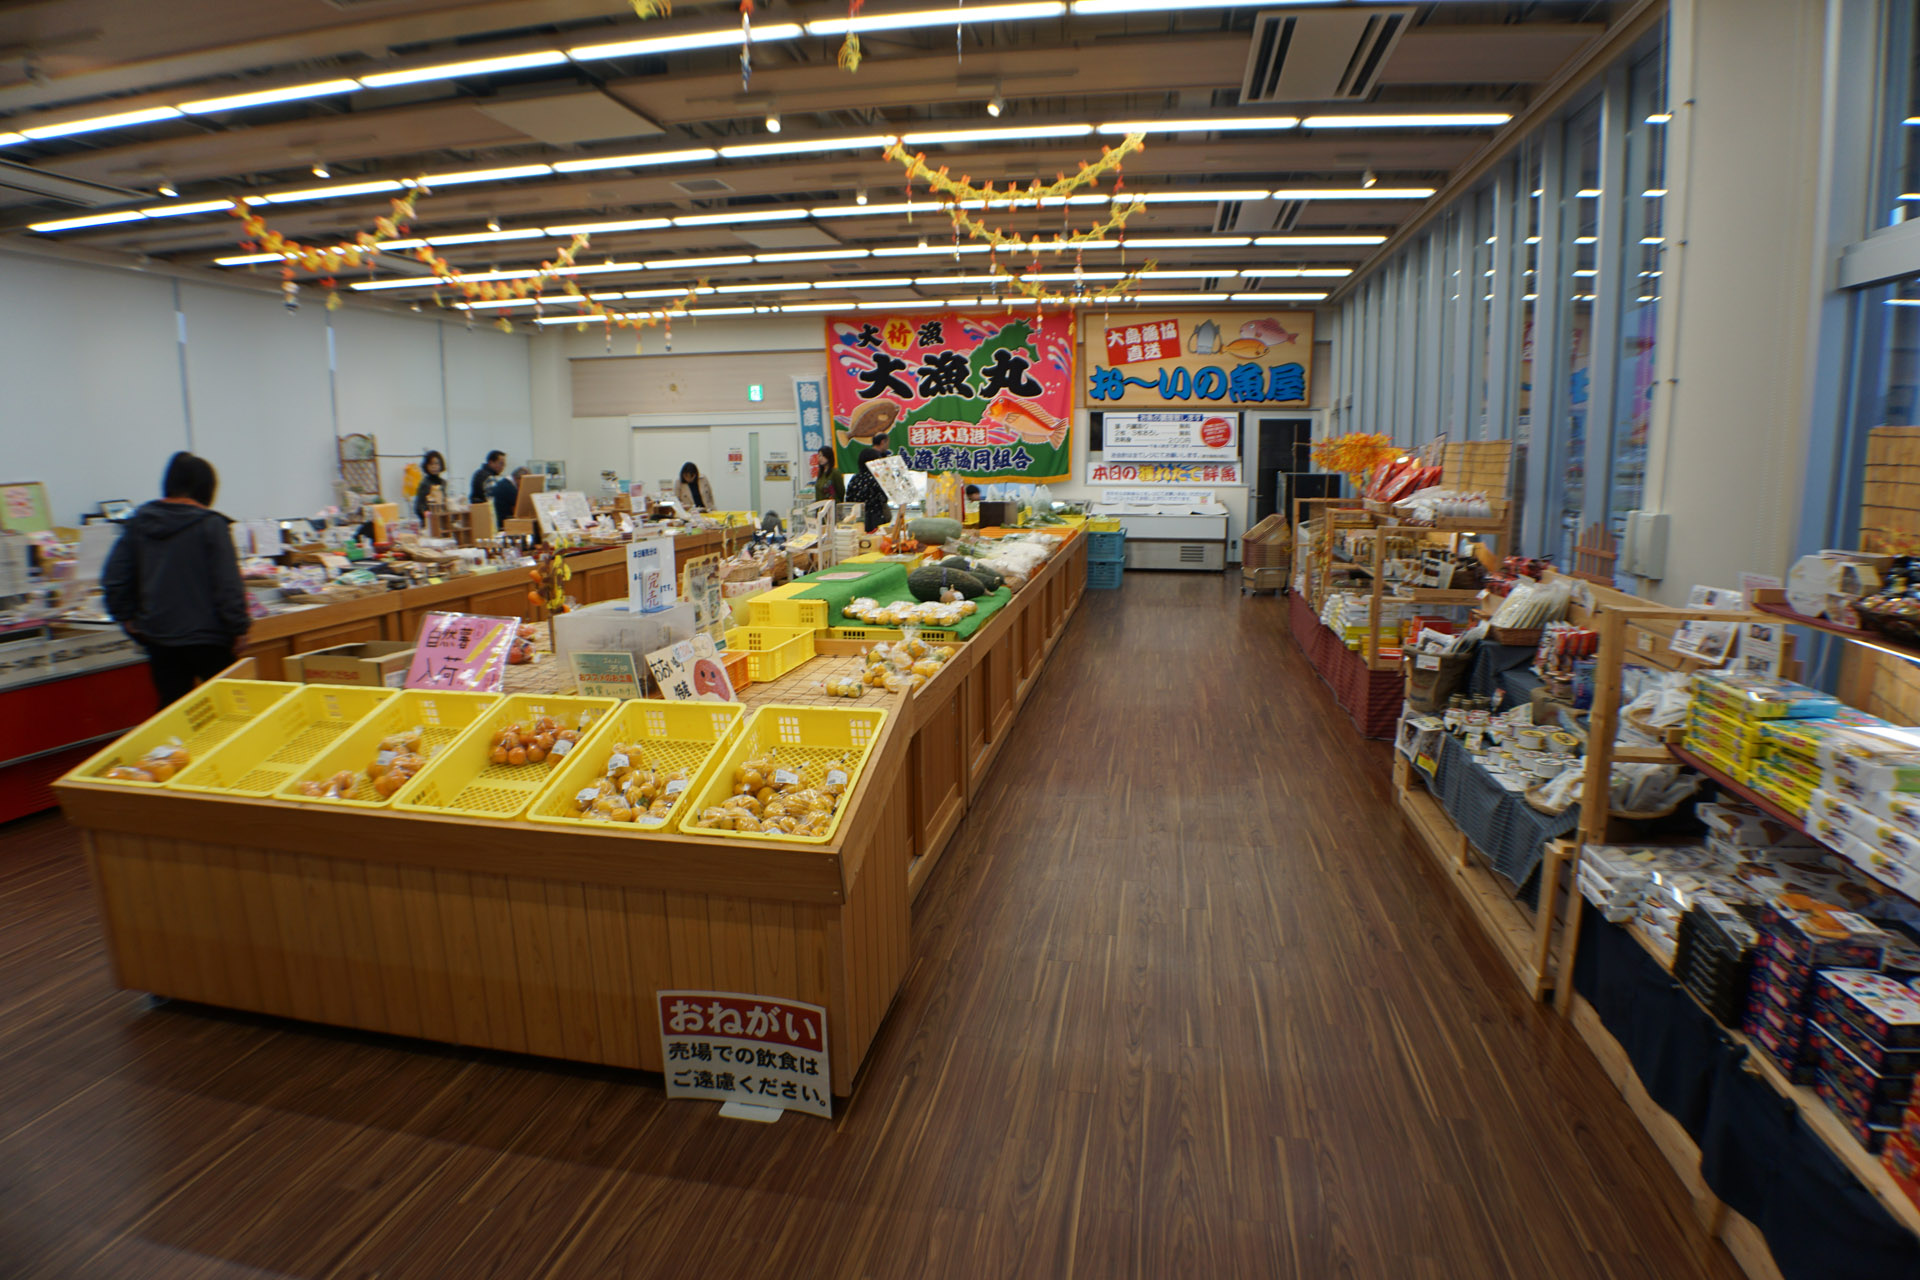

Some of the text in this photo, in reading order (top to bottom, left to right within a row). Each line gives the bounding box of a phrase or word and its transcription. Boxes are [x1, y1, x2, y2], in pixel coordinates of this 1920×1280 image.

[1106, 322, 1178, 347] 大島漁協
[1126, 342, 1162, 363] 直送
[857, 349, 1044, 400] 大漁丸
[910, 428, 986, 445] 若狭大島港
[886, 447, 1034, 471] 島漁業協同組合
[1092, 464, 1237, 483] 本日の獲れたて鮮魚
[415, 655, 463, 687] 入荷
[668, 999, 817, 1041] おねがい
[668, 1042, 820, 1076] 売場での飲食は
[673, 1069, 826, 1107] ご遠慮ください。
